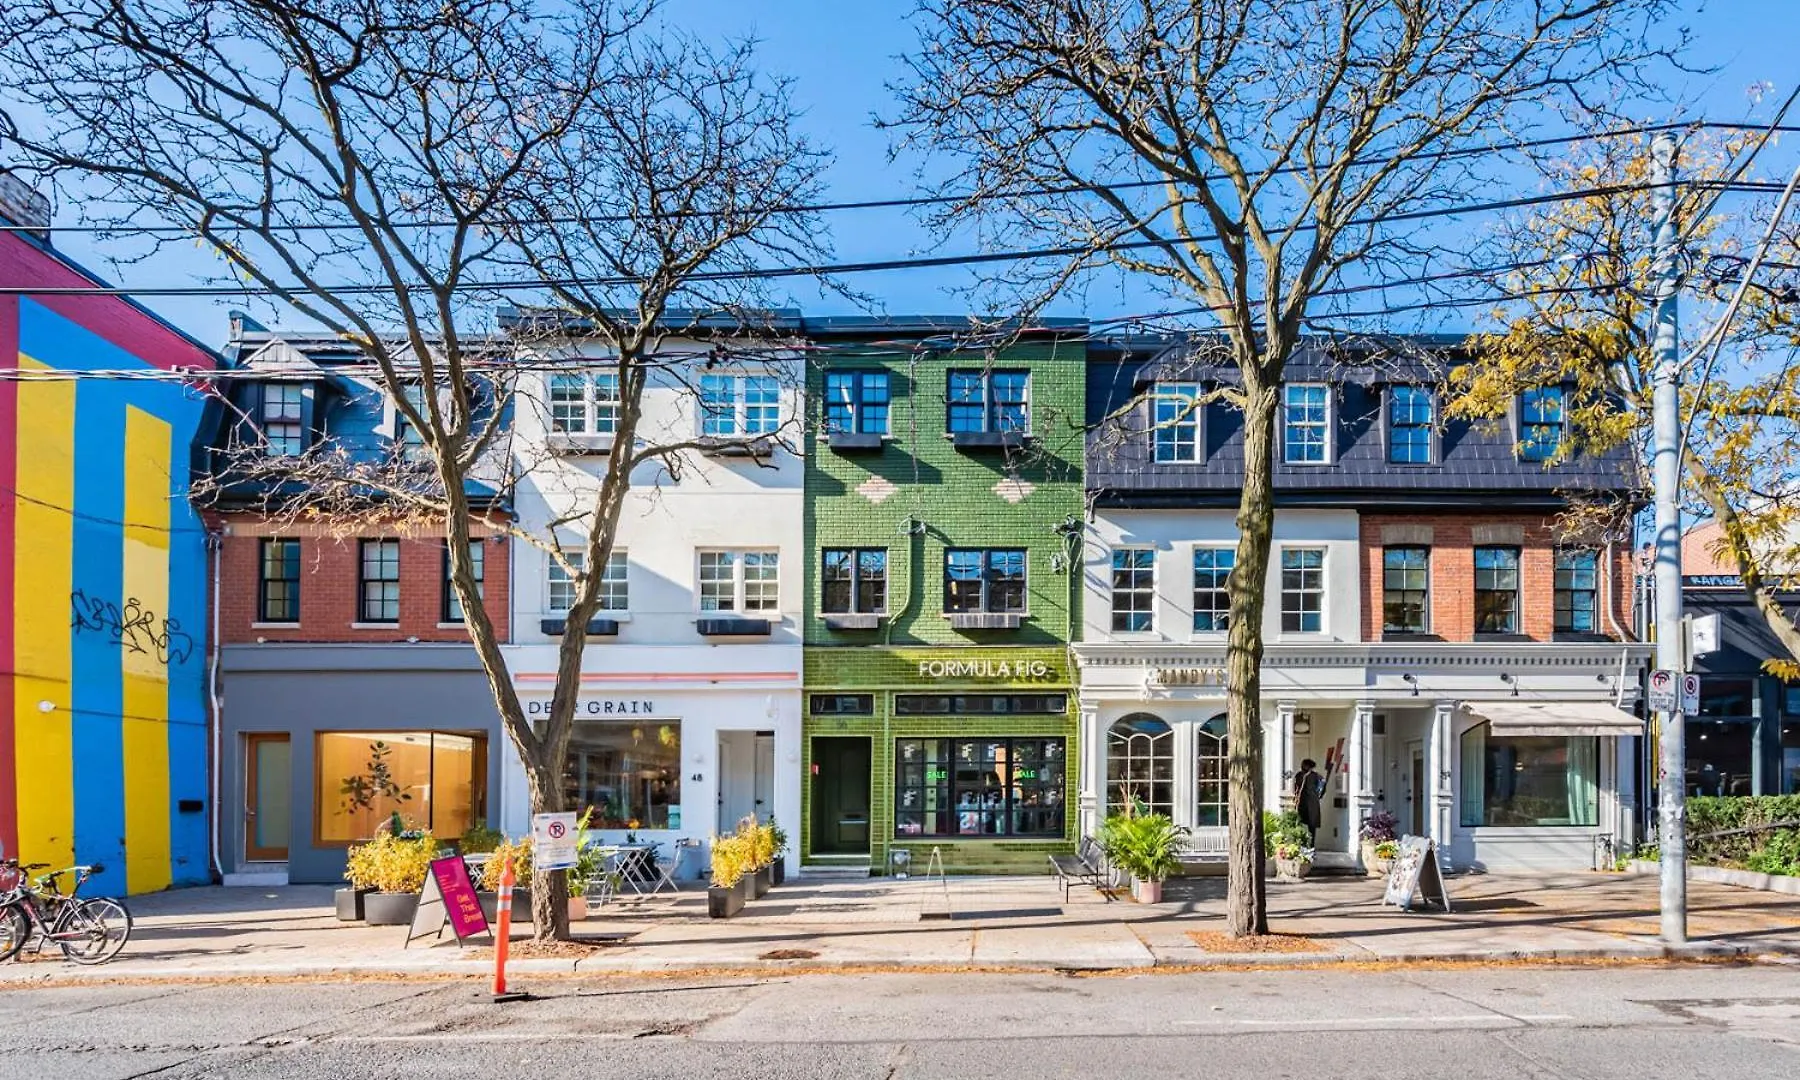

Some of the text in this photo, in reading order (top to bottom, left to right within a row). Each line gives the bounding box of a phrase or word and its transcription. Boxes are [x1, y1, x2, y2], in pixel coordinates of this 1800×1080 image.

[919, 660, 1047, 677] FORMULA FIG
[1157, 669, 1224, 684] MANDY'S
[528, 701, 653, 714] DE GRAIN
[927, 771, 947, 779] SALE
